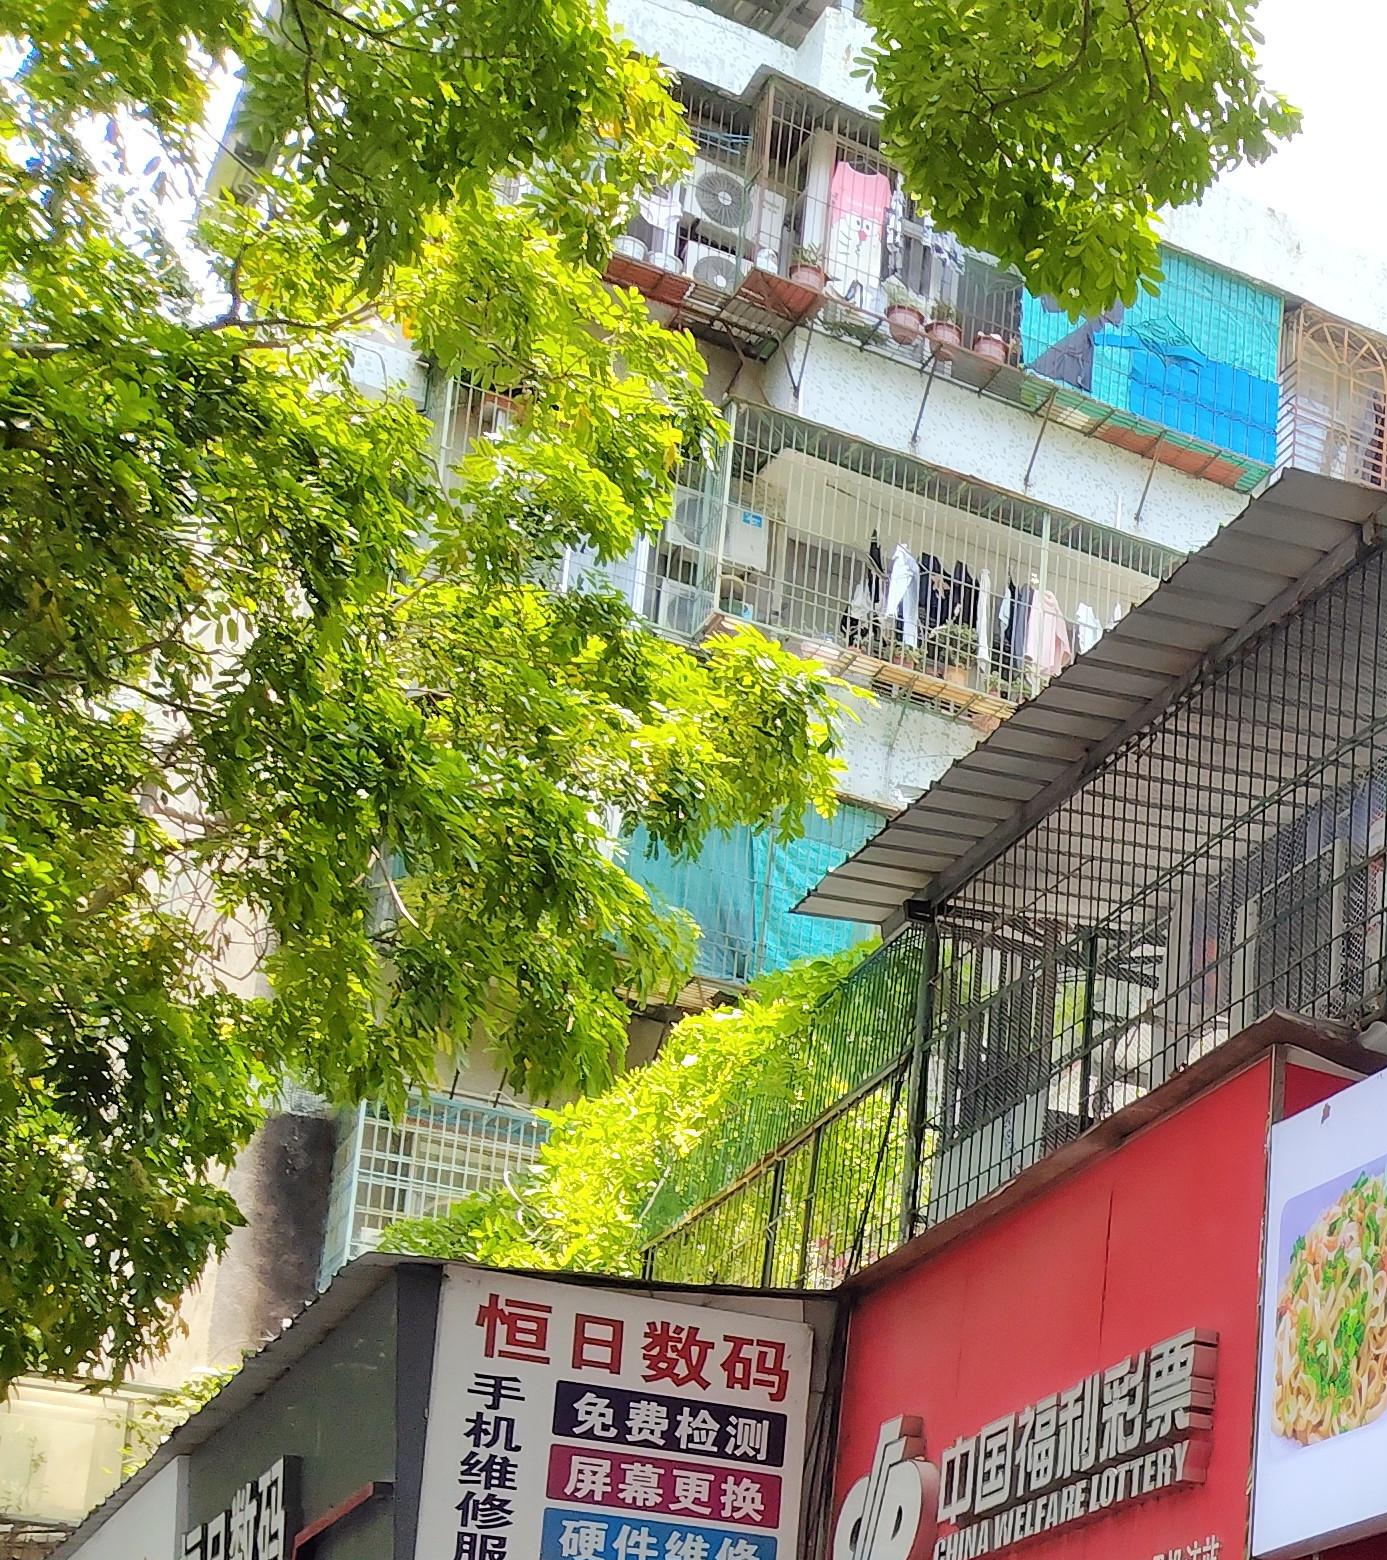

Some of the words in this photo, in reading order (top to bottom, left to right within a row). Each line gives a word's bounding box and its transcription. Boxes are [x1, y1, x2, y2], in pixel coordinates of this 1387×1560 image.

[476, 1294, 789, 1402] 恒日数码
[572, 1392, 770, 1461] 免费检测
[937, 1328, 1196, 1526] 中国福利彩票
[564, 1457, 766, 1522] 屏幕更换
[993, 1486, 1084, 1552] WELFARE
[1084, 1441, 1190, 1516] LOTTERY
